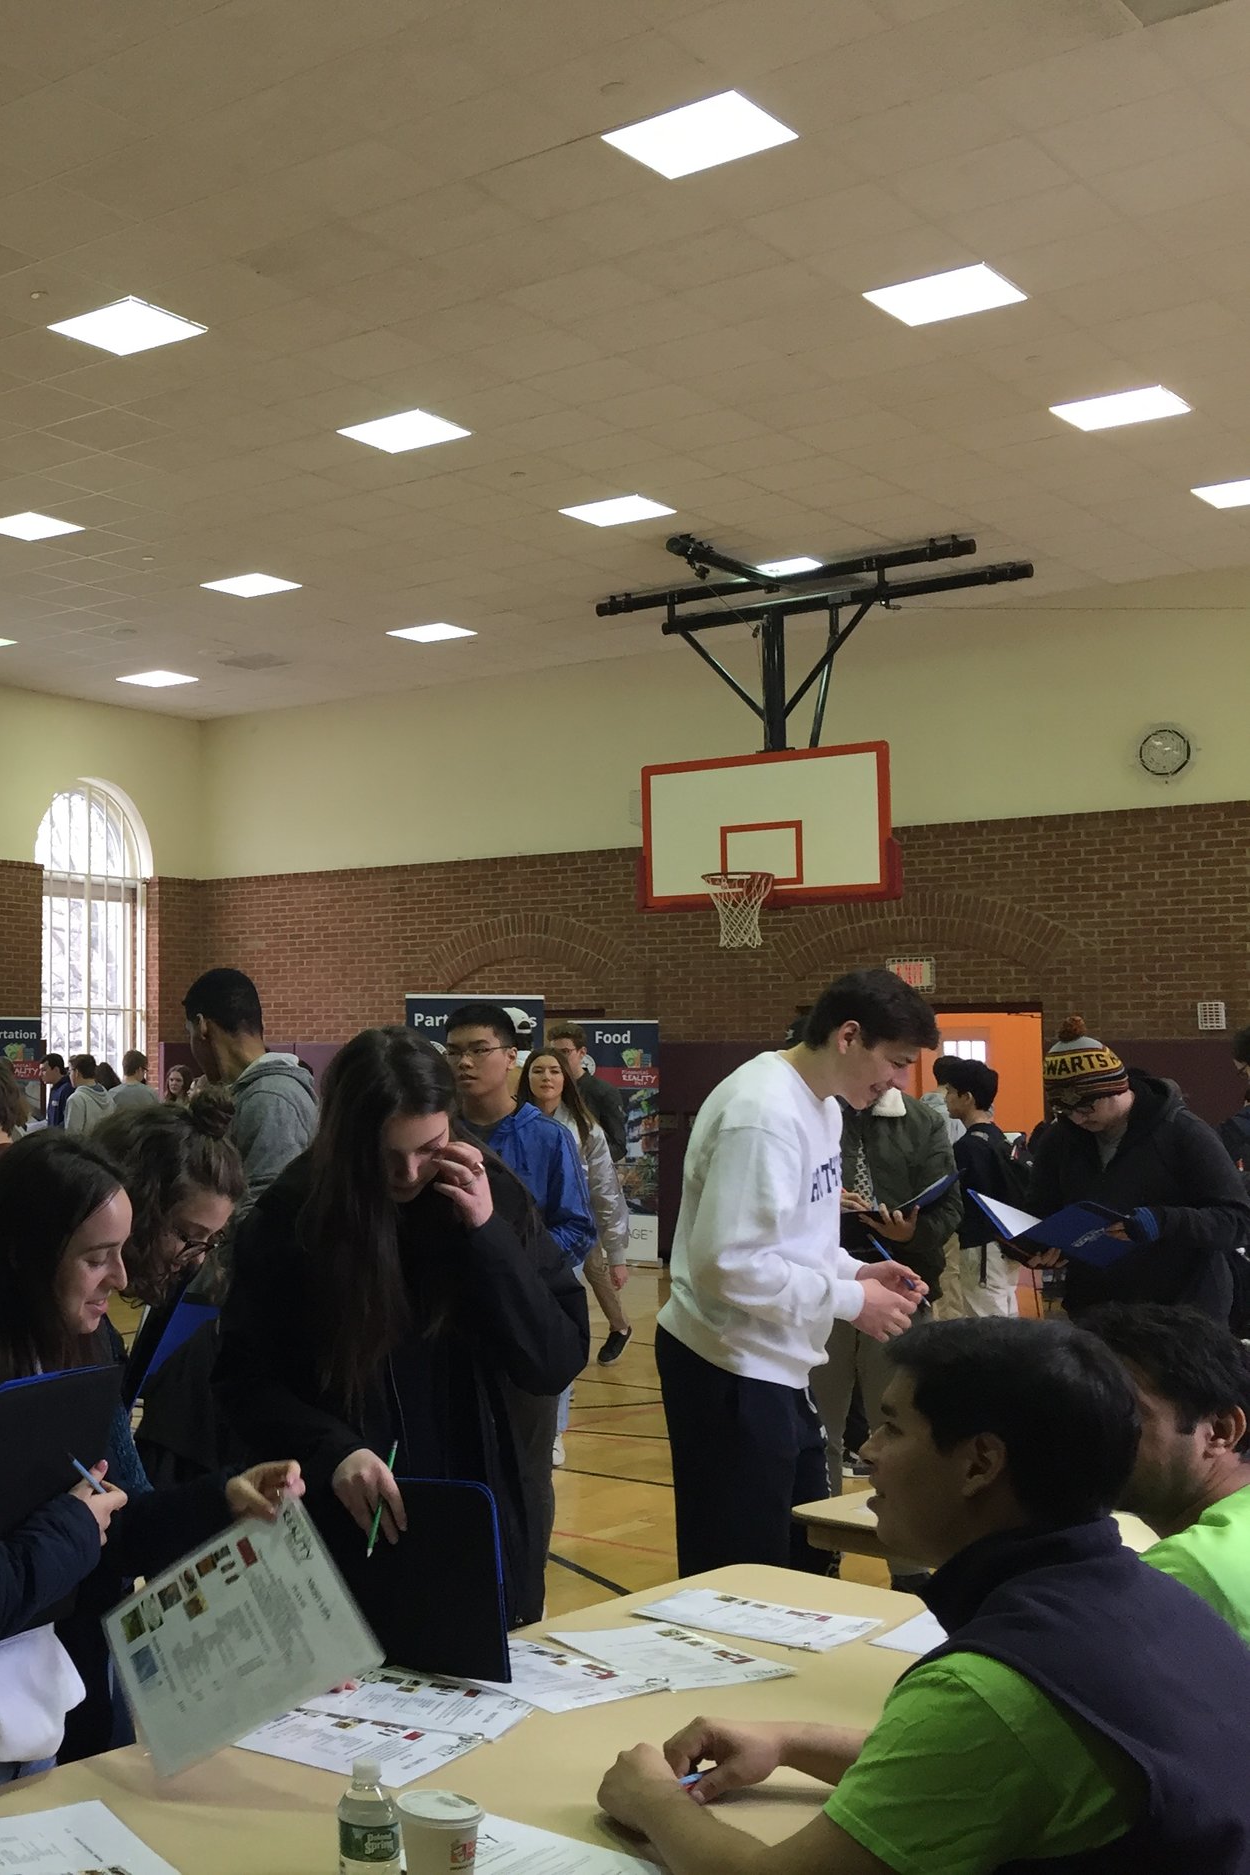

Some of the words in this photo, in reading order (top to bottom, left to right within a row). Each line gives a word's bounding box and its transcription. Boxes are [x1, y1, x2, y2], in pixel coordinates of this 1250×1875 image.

[595, 1030, 631, 1044] Food
[1044, 1053, 1109, 1076] WARTS
[14, 1067, 38, 1076] ALITY
[622, 1074, 657, 1084] REALITY
